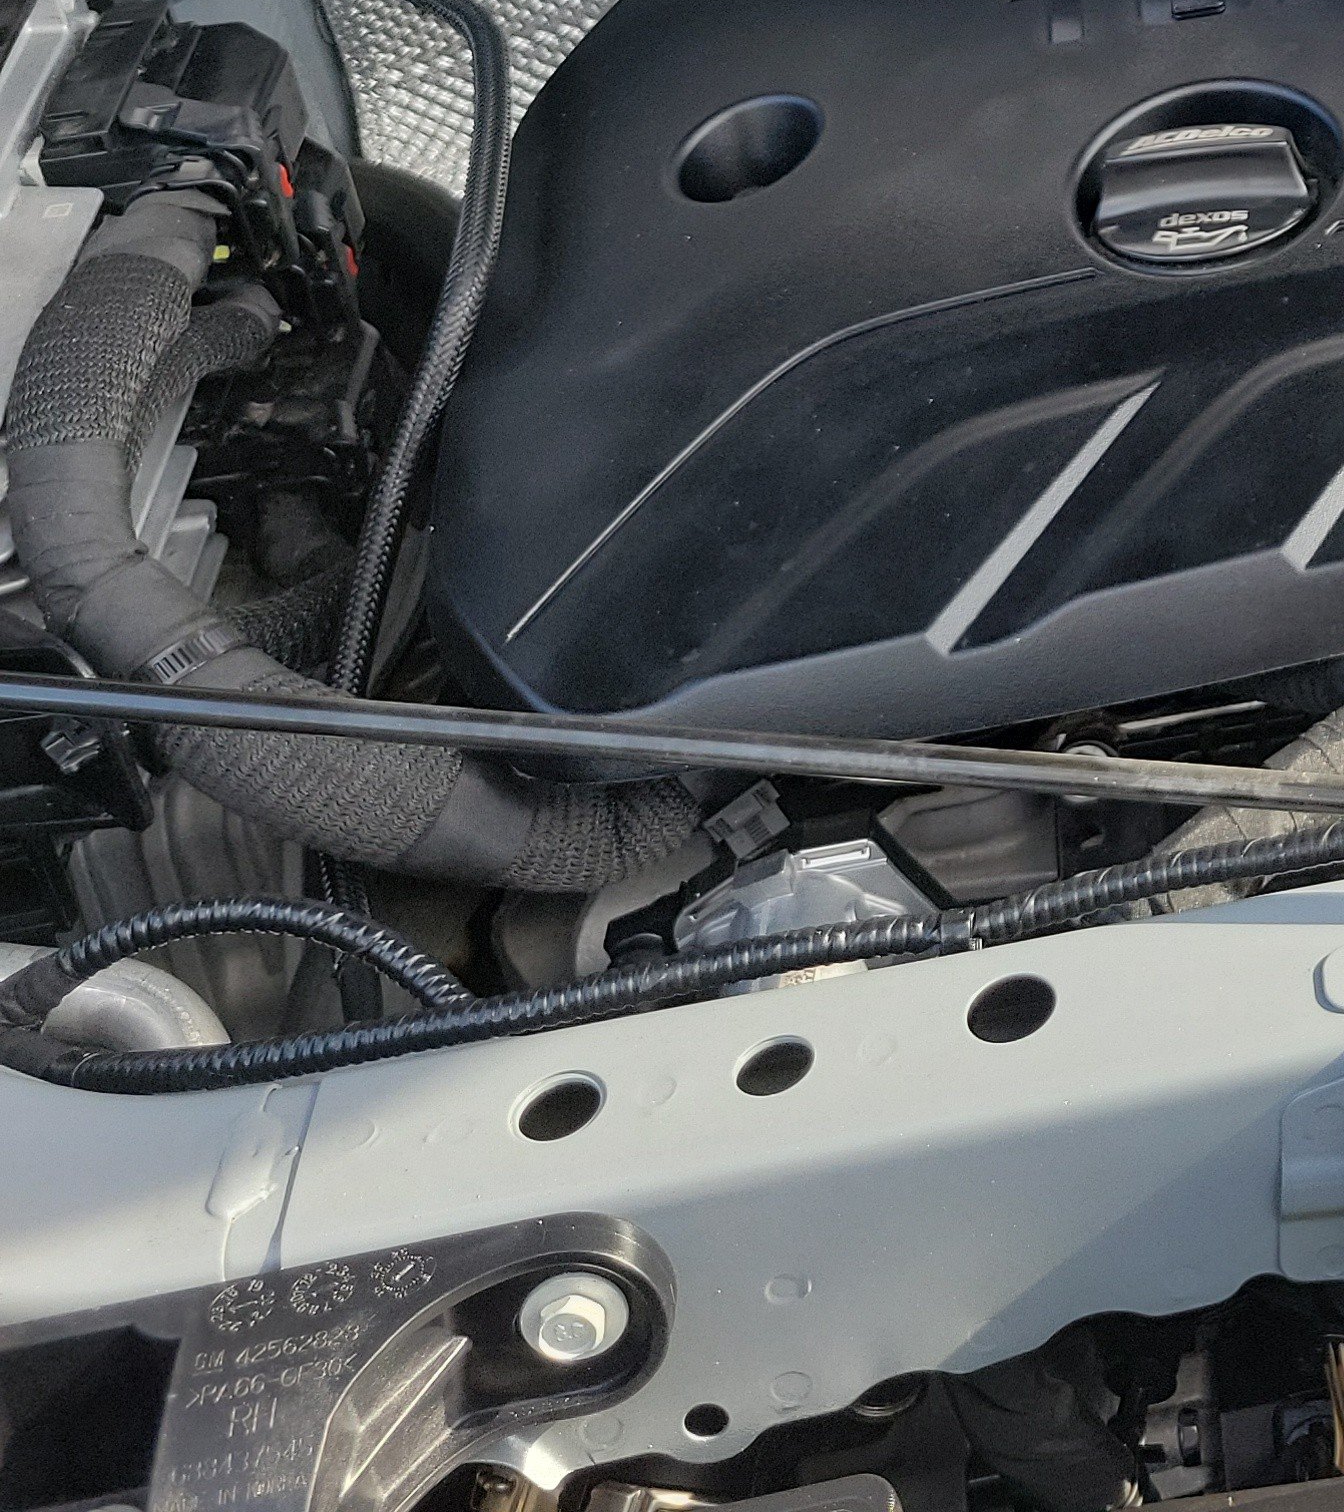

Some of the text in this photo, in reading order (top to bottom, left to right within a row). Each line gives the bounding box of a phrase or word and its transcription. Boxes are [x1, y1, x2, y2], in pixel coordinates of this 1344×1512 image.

[1120, 126, 1274, 156] ACDelco
[1160, 209, 1249, 228] dexos
[194, 1348, 226, 1372] GM
[227, 1397, 278, 1438] RH
